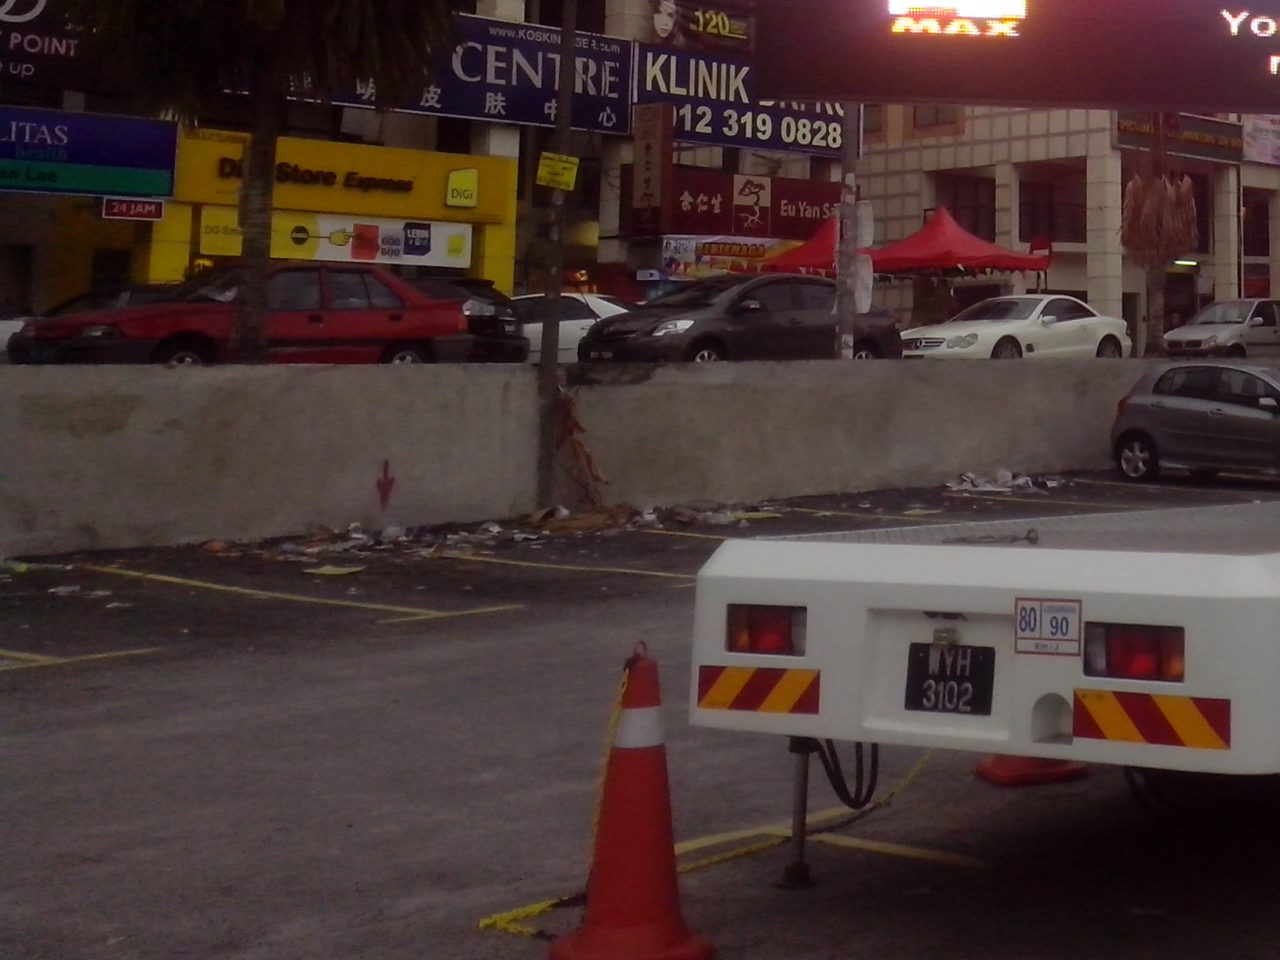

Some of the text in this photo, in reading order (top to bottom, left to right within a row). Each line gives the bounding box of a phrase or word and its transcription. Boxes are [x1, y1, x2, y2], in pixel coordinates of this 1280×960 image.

[488, 26, 622, 54] www.KOSKINSER.com
[891, 16, 1020, 37] MAX
[10, 32, 78, 57] POINT
[10, 63, 35, 78] up
[452, 42, 620, 100] CENTRE
[646, 52, 749, 104] KLINIK
[722, 109, 773, 141] 319
[781, 116, 843, 150] 0828
[276, 161, 337, 187] Store
[342, 170, 415, 193] Express
[450, 187, 474, 200] DiGi
[112, 201, 156, 216] 24 JAM
[780, 199, 796, 217] Eu
[798, 201, 820, 219] Yan
[1019, 606, 1069, 637] 80 90
[928, 646, 971, 677] WYH
[922, 679, 973, 713] 3102
